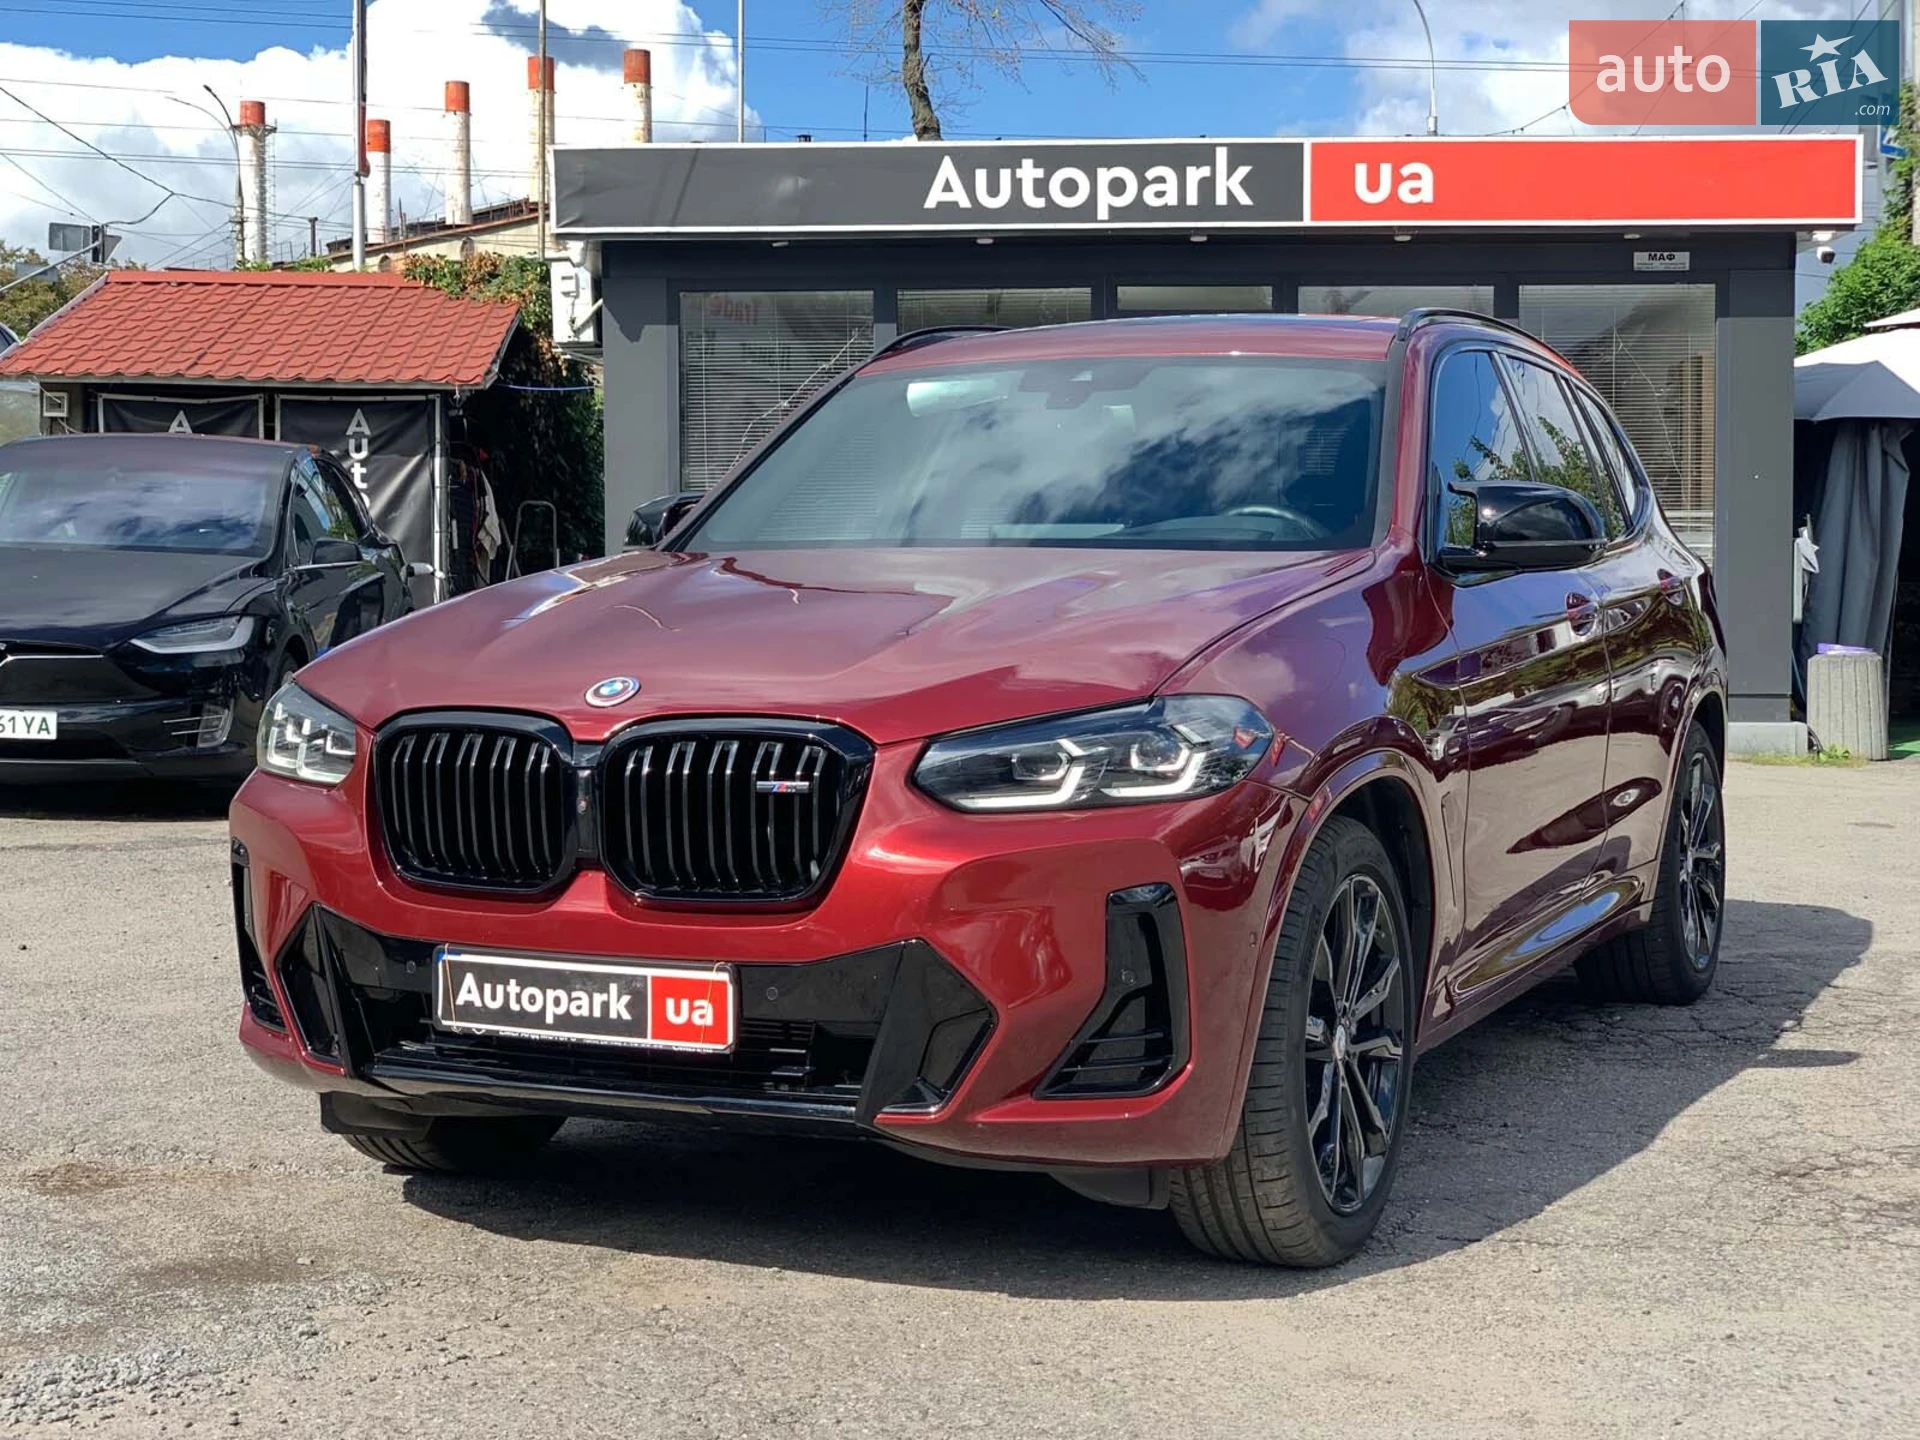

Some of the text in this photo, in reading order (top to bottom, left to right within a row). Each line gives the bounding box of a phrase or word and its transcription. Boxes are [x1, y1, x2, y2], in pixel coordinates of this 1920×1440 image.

[922, 147, 1435, 221] Autopark ua
[455, 971, 714, 1027] Autopark ua
